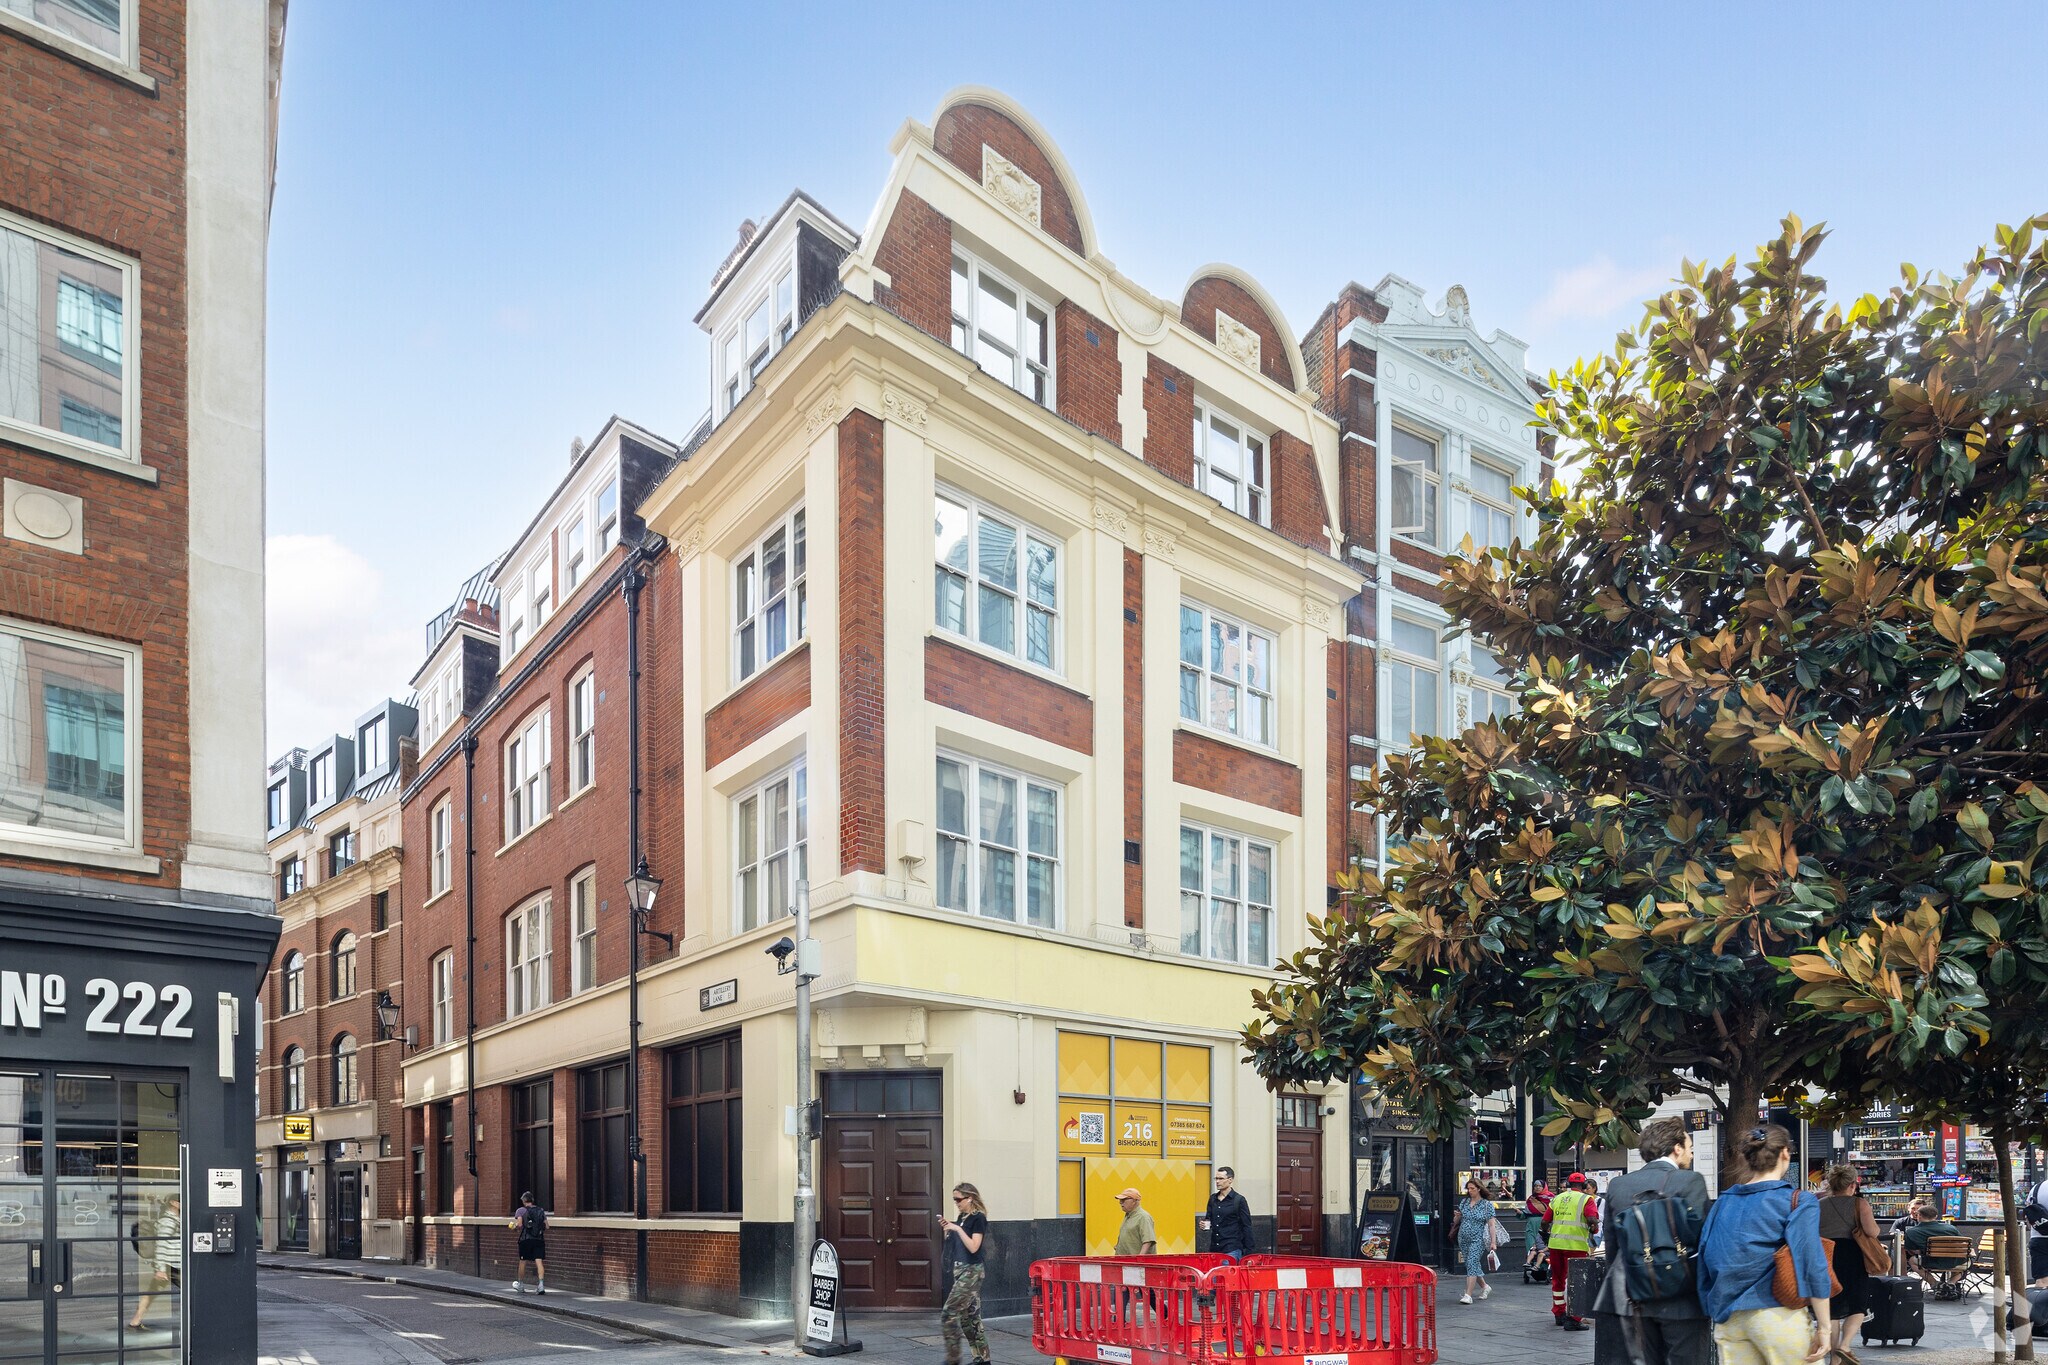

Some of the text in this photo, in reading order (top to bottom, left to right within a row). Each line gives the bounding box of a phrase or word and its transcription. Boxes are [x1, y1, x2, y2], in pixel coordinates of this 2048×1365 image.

[712, 985, 732, 996] ARTILLERY
[712, 994, 723, 1003] LANE
[85, 978, 194, 1038] 222
[1123, 1122, 1153, 1140] 216
[1117, 1139, 1159, 1147] BISHOPSGATE
[1290, 1158, 1301, 1167] 214
[816, 1250, 830, 1263] SUR
[813, 1277, 835, 1291] BARBER
[815, 1289, 831, 1301] SHOP
[1104, 1350, 1132, 1359] RINGWAY
